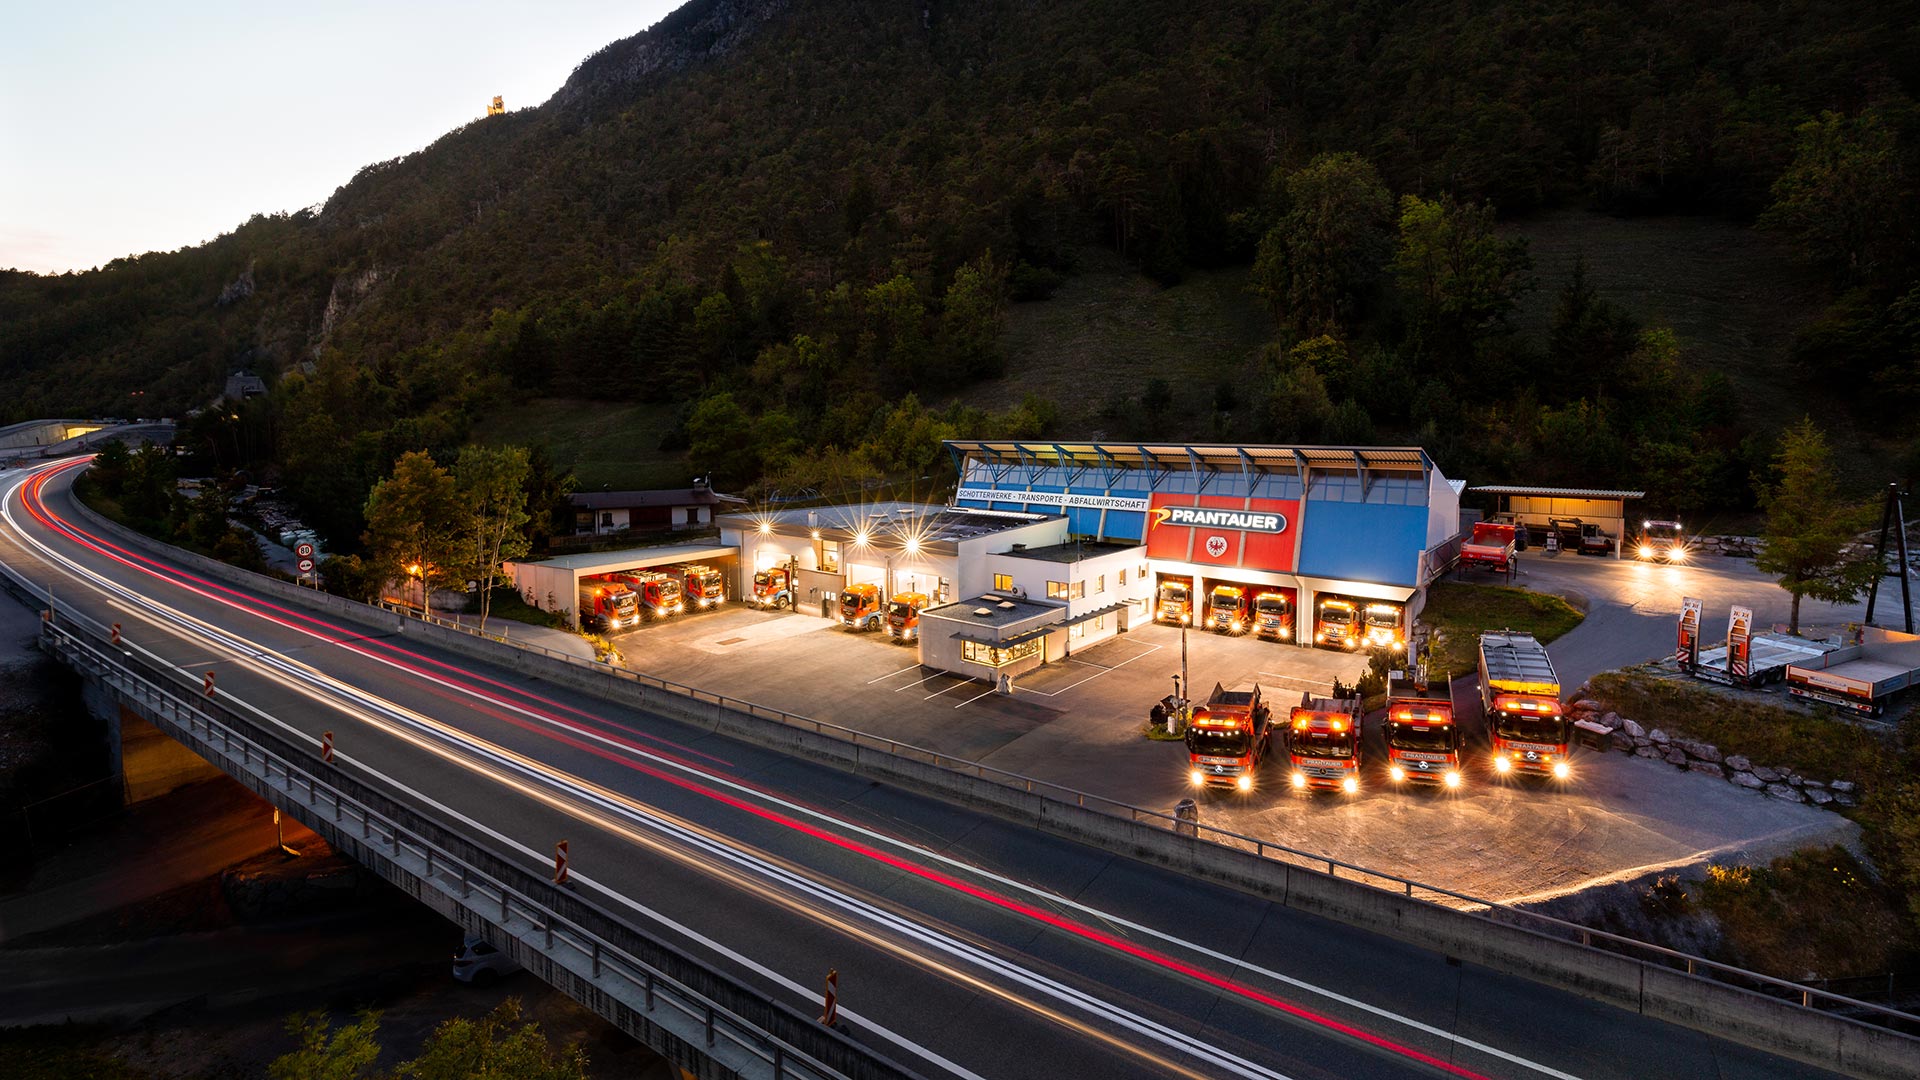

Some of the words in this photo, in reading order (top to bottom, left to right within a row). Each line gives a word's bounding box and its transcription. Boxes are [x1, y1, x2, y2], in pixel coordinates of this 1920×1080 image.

[958, 489, 1012, 500] SCHOTTERWERKE
[1017, 493, 1063, 504] TRANSPORTE
[1068, 496, 1146, 509] ABFALLWIRTSCHAFT
[1172, 509, 1278, 530] PRANTAUER
[1405, 752, 1445, 760] PRANTAUER
